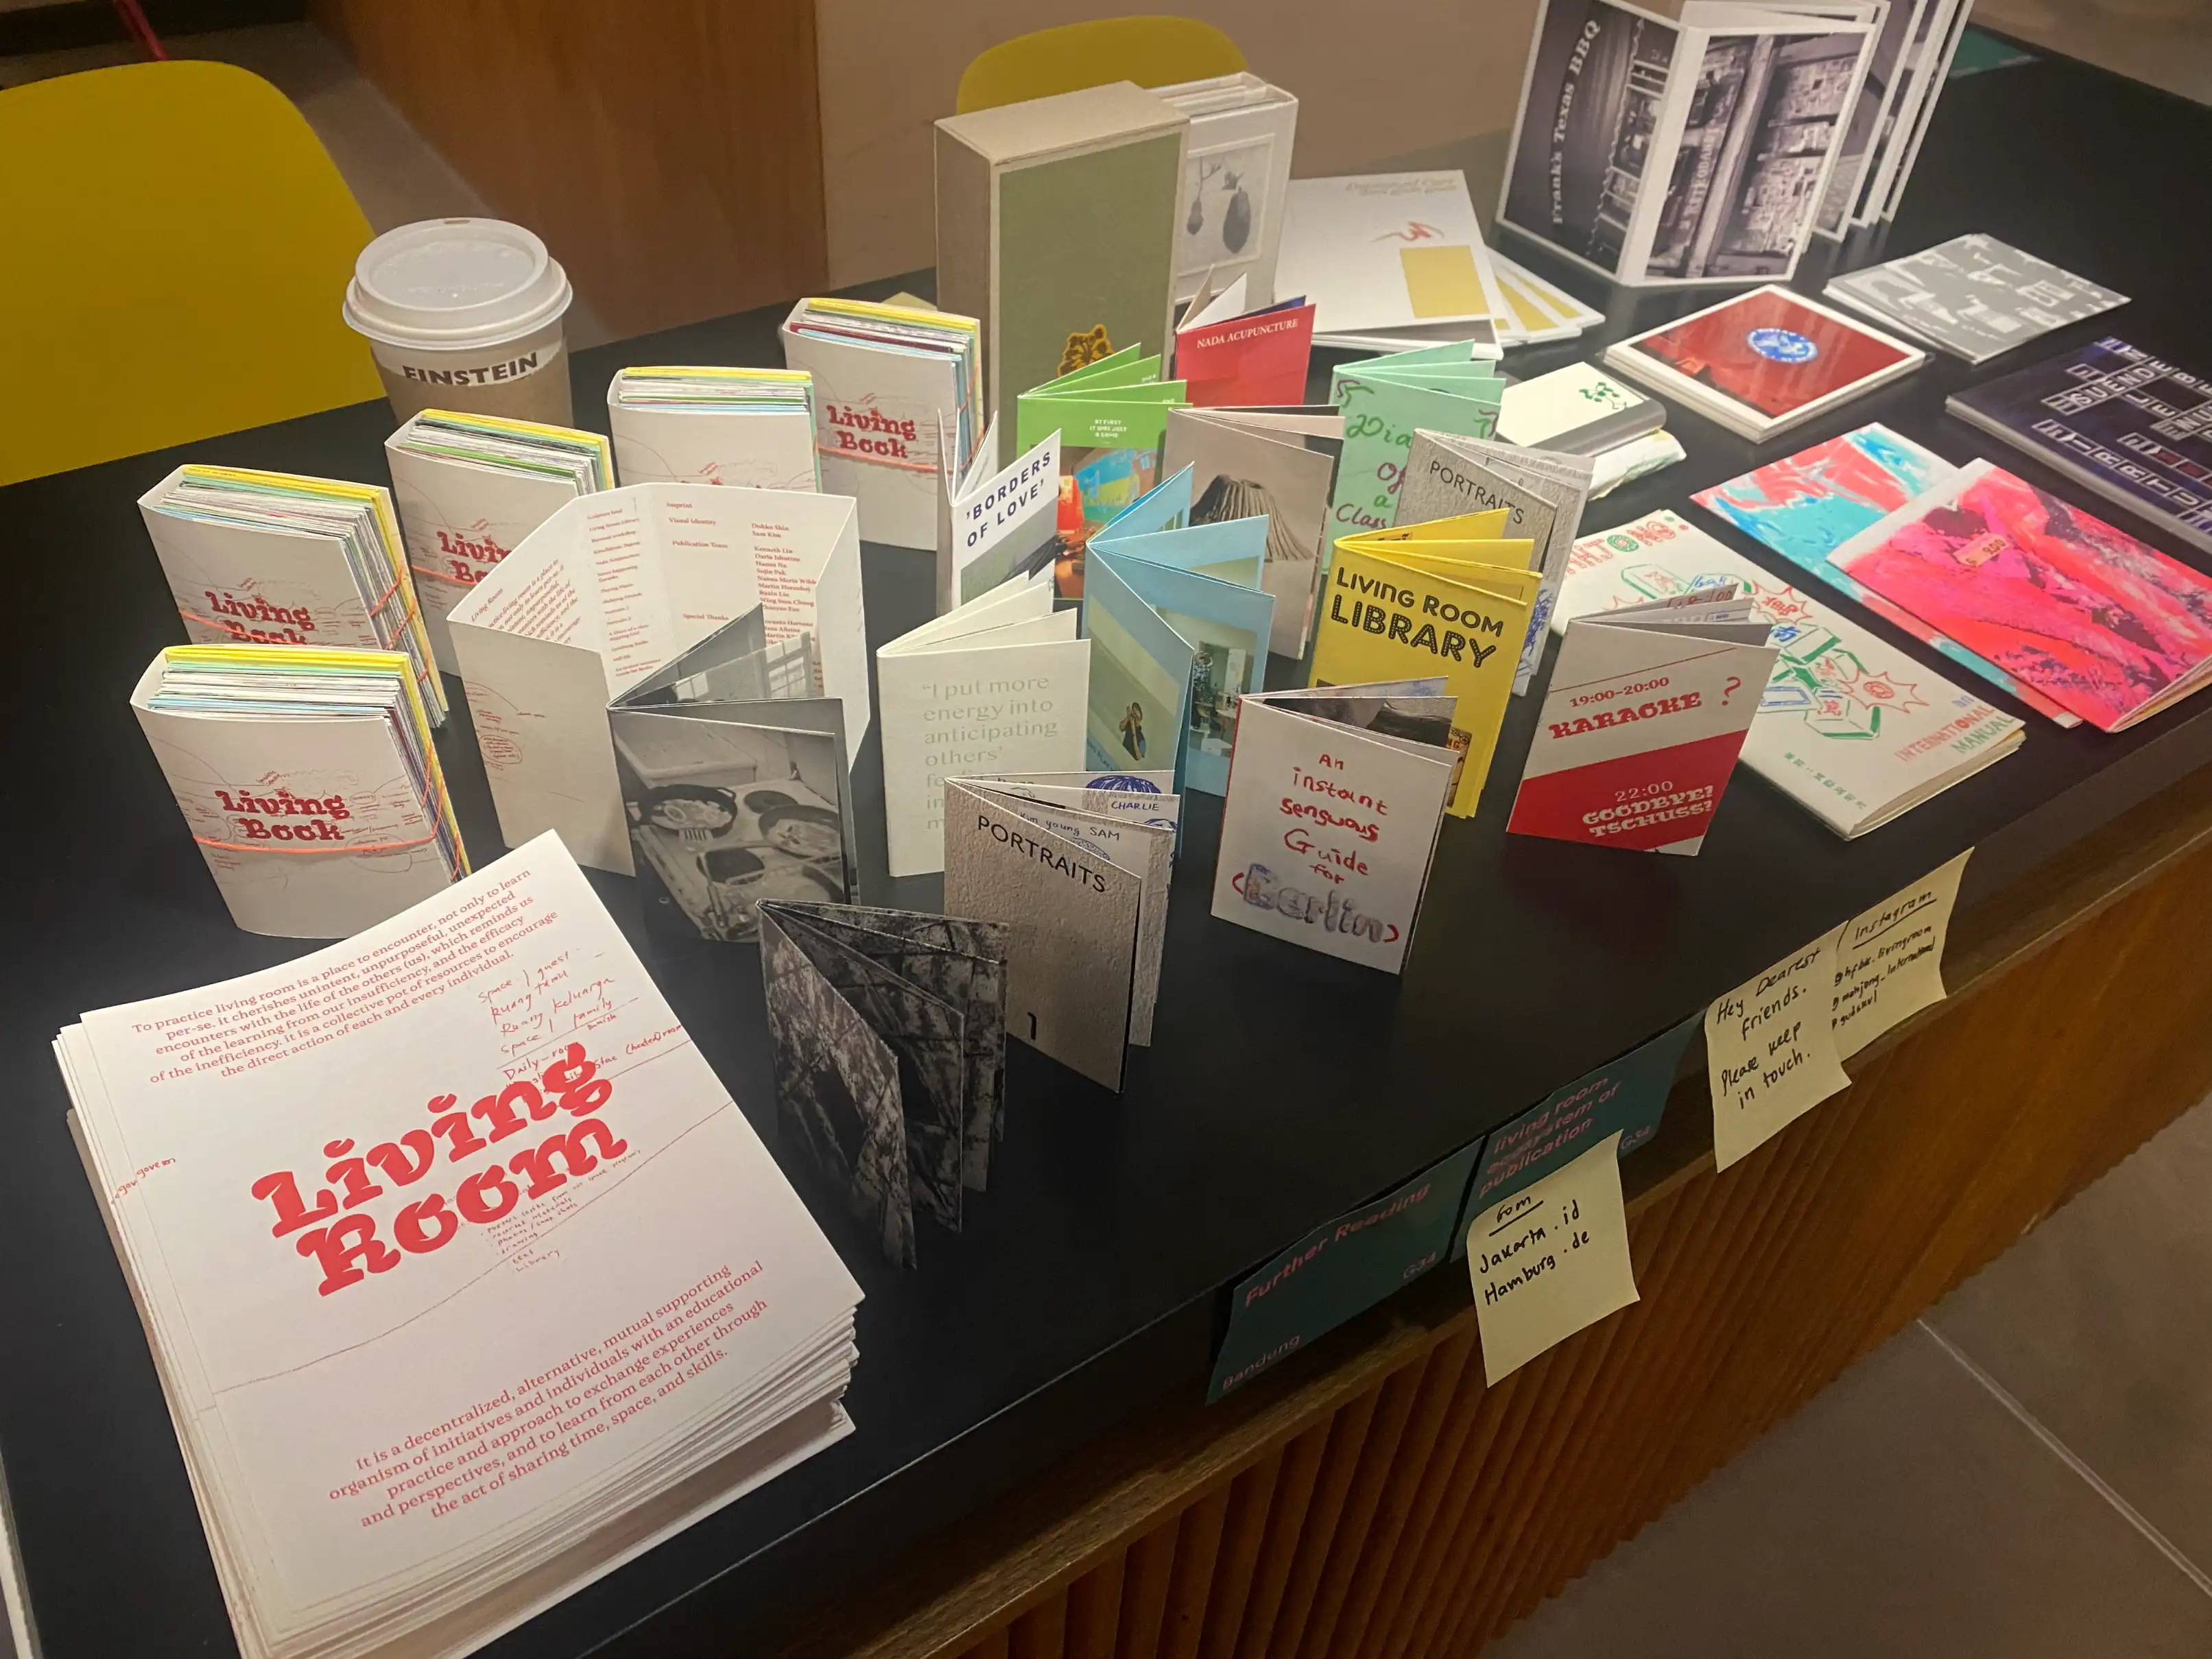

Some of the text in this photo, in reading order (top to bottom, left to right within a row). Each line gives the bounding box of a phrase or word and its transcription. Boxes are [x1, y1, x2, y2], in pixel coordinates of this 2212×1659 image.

[1553, 82, 1575, 143] Texas
[1568, 19, 1601, 76] BBQ
[1197, 318, 1299, 349] NADA ACUPUNCTURE
[402, 352, 538, 386] EINSTEIN
[826, 405, 917, 441] Living
[836, 430, 909, 459] Book
[1336, 503, 1387, 529] Class
[1374, 494, 1393, 508] a
[967, 522, 988, 547] OF
[204, 590, 316, 632] Living
[470, 588, 503, 622] Living Room
[1336, 566, 1504, 638] LIVING ROOM
[1330, 593, 1497, 669] LIBRARY
[923, 698, 1054, 721] energy into
[944, 679, 982, 700] put
[989, 677, 1050, 693] more
[1547, 676, 1741, 740] KARAOKE ?
[923, 721, 1058, 744] anticipating
[1950, 715, 2017, 754] MANUAL
[1318, 754, 1344, 771] An
[214, 788, 351, 820] Living
[1110, 800, 1161, 812] CHARLIE
[1292, 767, 1390, 815] instant
[1613, 780, 1674, 802] 22:00
[238, 817, 346, 842] Book
[1045, 819, 1080, 837] young
[1089, 826, 1121, 842] SAM
[1283, 828, 1370, 876] Guide
[977, 814, 1106, 894] PORTRAITS
[1309, 863, 1345, 885] for
[1854, 891, 1933, 940] Instagram
[132, 869, 531, 1034] To practice living room is a place to encounter, not only to learn
[165, 891, 517, 1041] per-se. it cherishes unintent, unpurposeful, unexpected
[180, 915, 524, 1062] of the learning from our insufficiency, and the efficacy
[1717, 947, 1821, 1025] Hey Dearest
[219, 949, 514, 1077] the direct action of each and every individual.
[1741, 985, 1807, 1042] friends.
[1721, 1021, 1802, 1097] Please keep
[1737, 1048, 1811, 1110] in touch.
[1597, 1079, 1624, 1104] of
[250, 1041, 613, 1239] Living
[1493, 1077, 1609, 1155] living room
[1478, 1117, 1594, 1200] publication
[295, 1117, 629, 1298] Room
[1244, 1182, 1431, 1309] Further Reading
[1479, 1227, 1547, 1274] Jakarta
[1484, 1254, 1557, 1306] Hamburg
[355, 1264, 733, 1471] It is a decentralized, alternative, mutual supporting
[1222, 1335, 1300, 1392] Bandung
[386, 1302, 734, 1500] practice and approach to exchange experiences
[430, 1347, 728, 1519] the act of sharing time, space, and skills.
